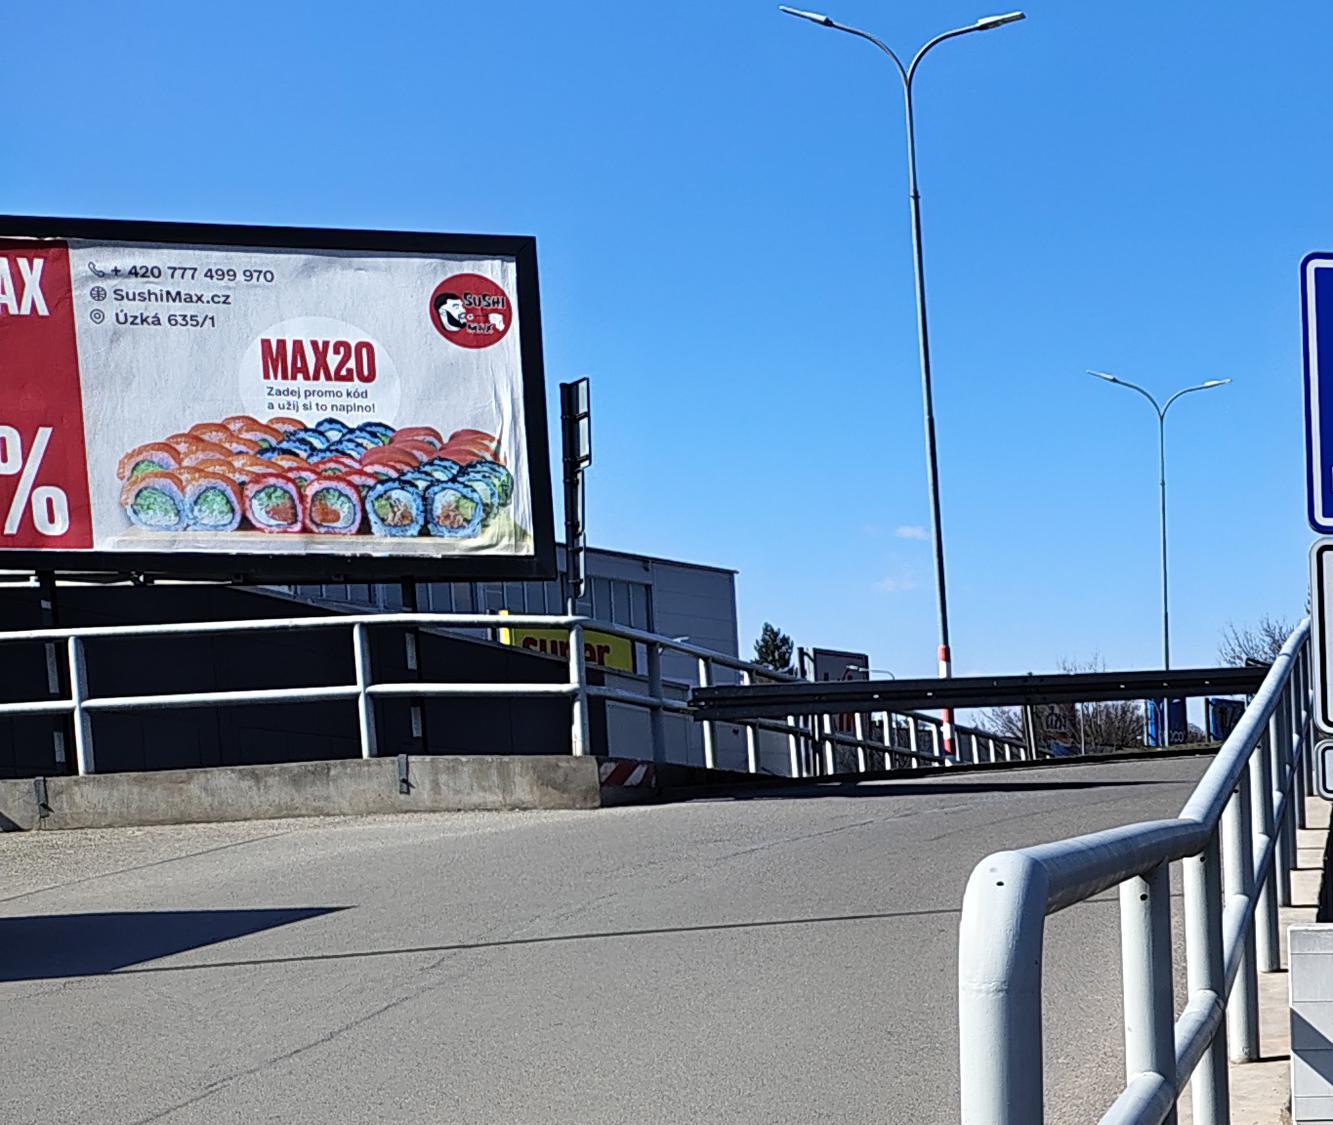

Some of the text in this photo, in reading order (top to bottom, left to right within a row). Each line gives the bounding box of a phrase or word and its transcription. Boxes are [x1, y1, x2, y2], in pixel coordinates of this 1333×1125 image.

[127, 265, 162, 279] 420
[167, 266, 198, 280] 777
[203, 267, 237, 282] 499
[242, 268, 275, 283] 970
[113, 288, 232, 305] SushiMax.cz
[115, 308, 216, 329] Úzká 635/1
[260, 338, 377, 384] MAX20
[266, 386, 368, 400] Zadej promo kód
[267, 400, 375, 414] a užij si to naplno!
